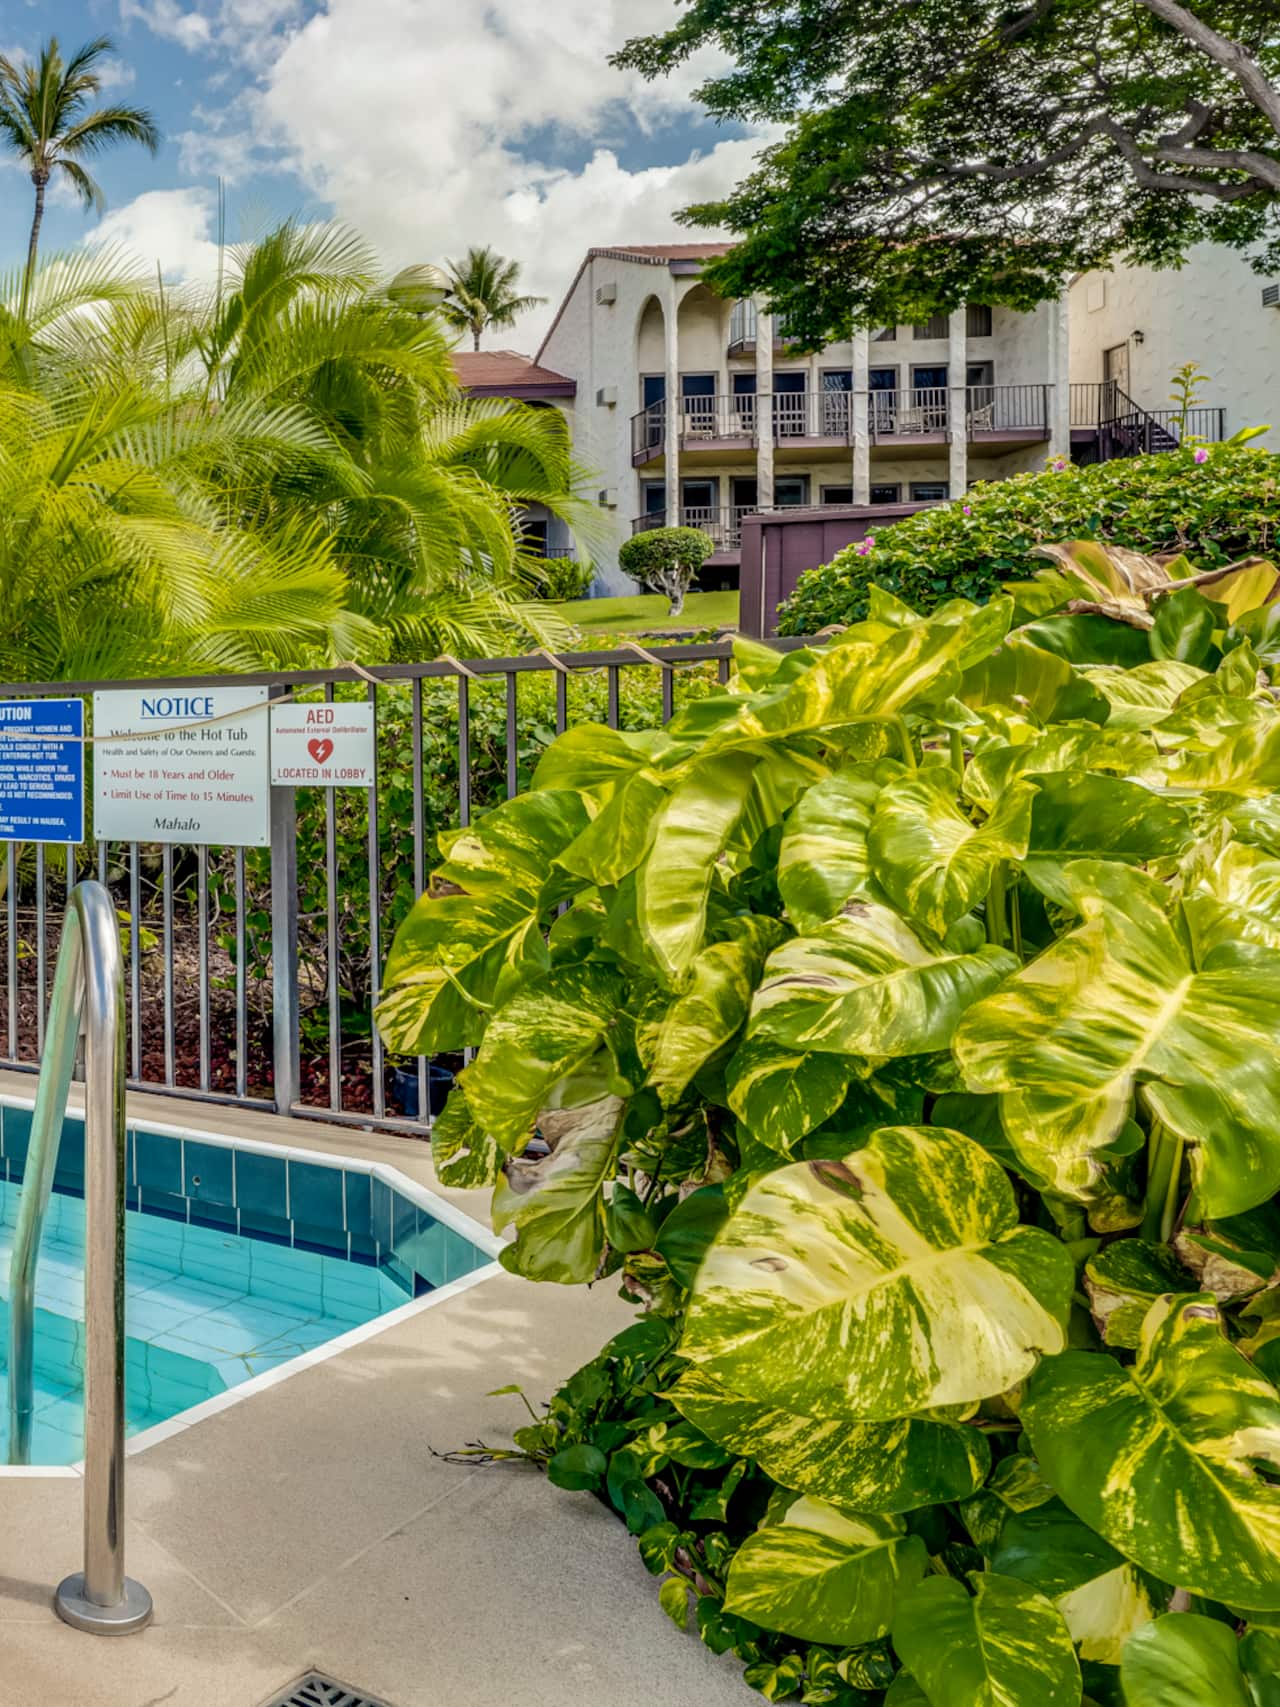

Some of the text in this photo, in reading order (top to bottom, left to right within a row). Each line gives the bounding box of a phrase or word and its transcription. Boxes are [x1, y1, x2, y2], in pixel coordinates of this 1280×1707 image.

[141, 697, 214, 717] NOTICE
[306, 709, 334, 724] AED
[164, 730, 175, 740] to
[179, 729, 197, 741] the
[201, 729, 221, 741] Hot
[226, 728, 247, 740] Tub
[3, 752, 30, 760] ENTERING
[32, 752, 44, 760] HOT
[140, 749, 159, 757] Safety
[54, 774, 75, 782] DRUGS
[111, 770, 132, 778] Must
[149, 770, 159, 778] 18
[162, 770, 185, 779] Years
[188, 770, 204, 780] and
[208, 770, 235, 780] Older
[278, 768, 366, 779] LOCATED IN LOBBY
[4, 782, 18, 790] LEAD
[20, 782, 27, 790] TO
[29, 782, 54, 790] SERIOUS
[111, 791, 131, 799] Limit
[154, 791, 163, 800] of
[166, 791, 187, 800] Time
[191, 792, 199, 800] to
[204, 792, 212, 801] 15
[217, 792, 254, 802] Minutes
[10, 816, 31, 824] RESULT
[154, 817, 200, 831] Mahalo
